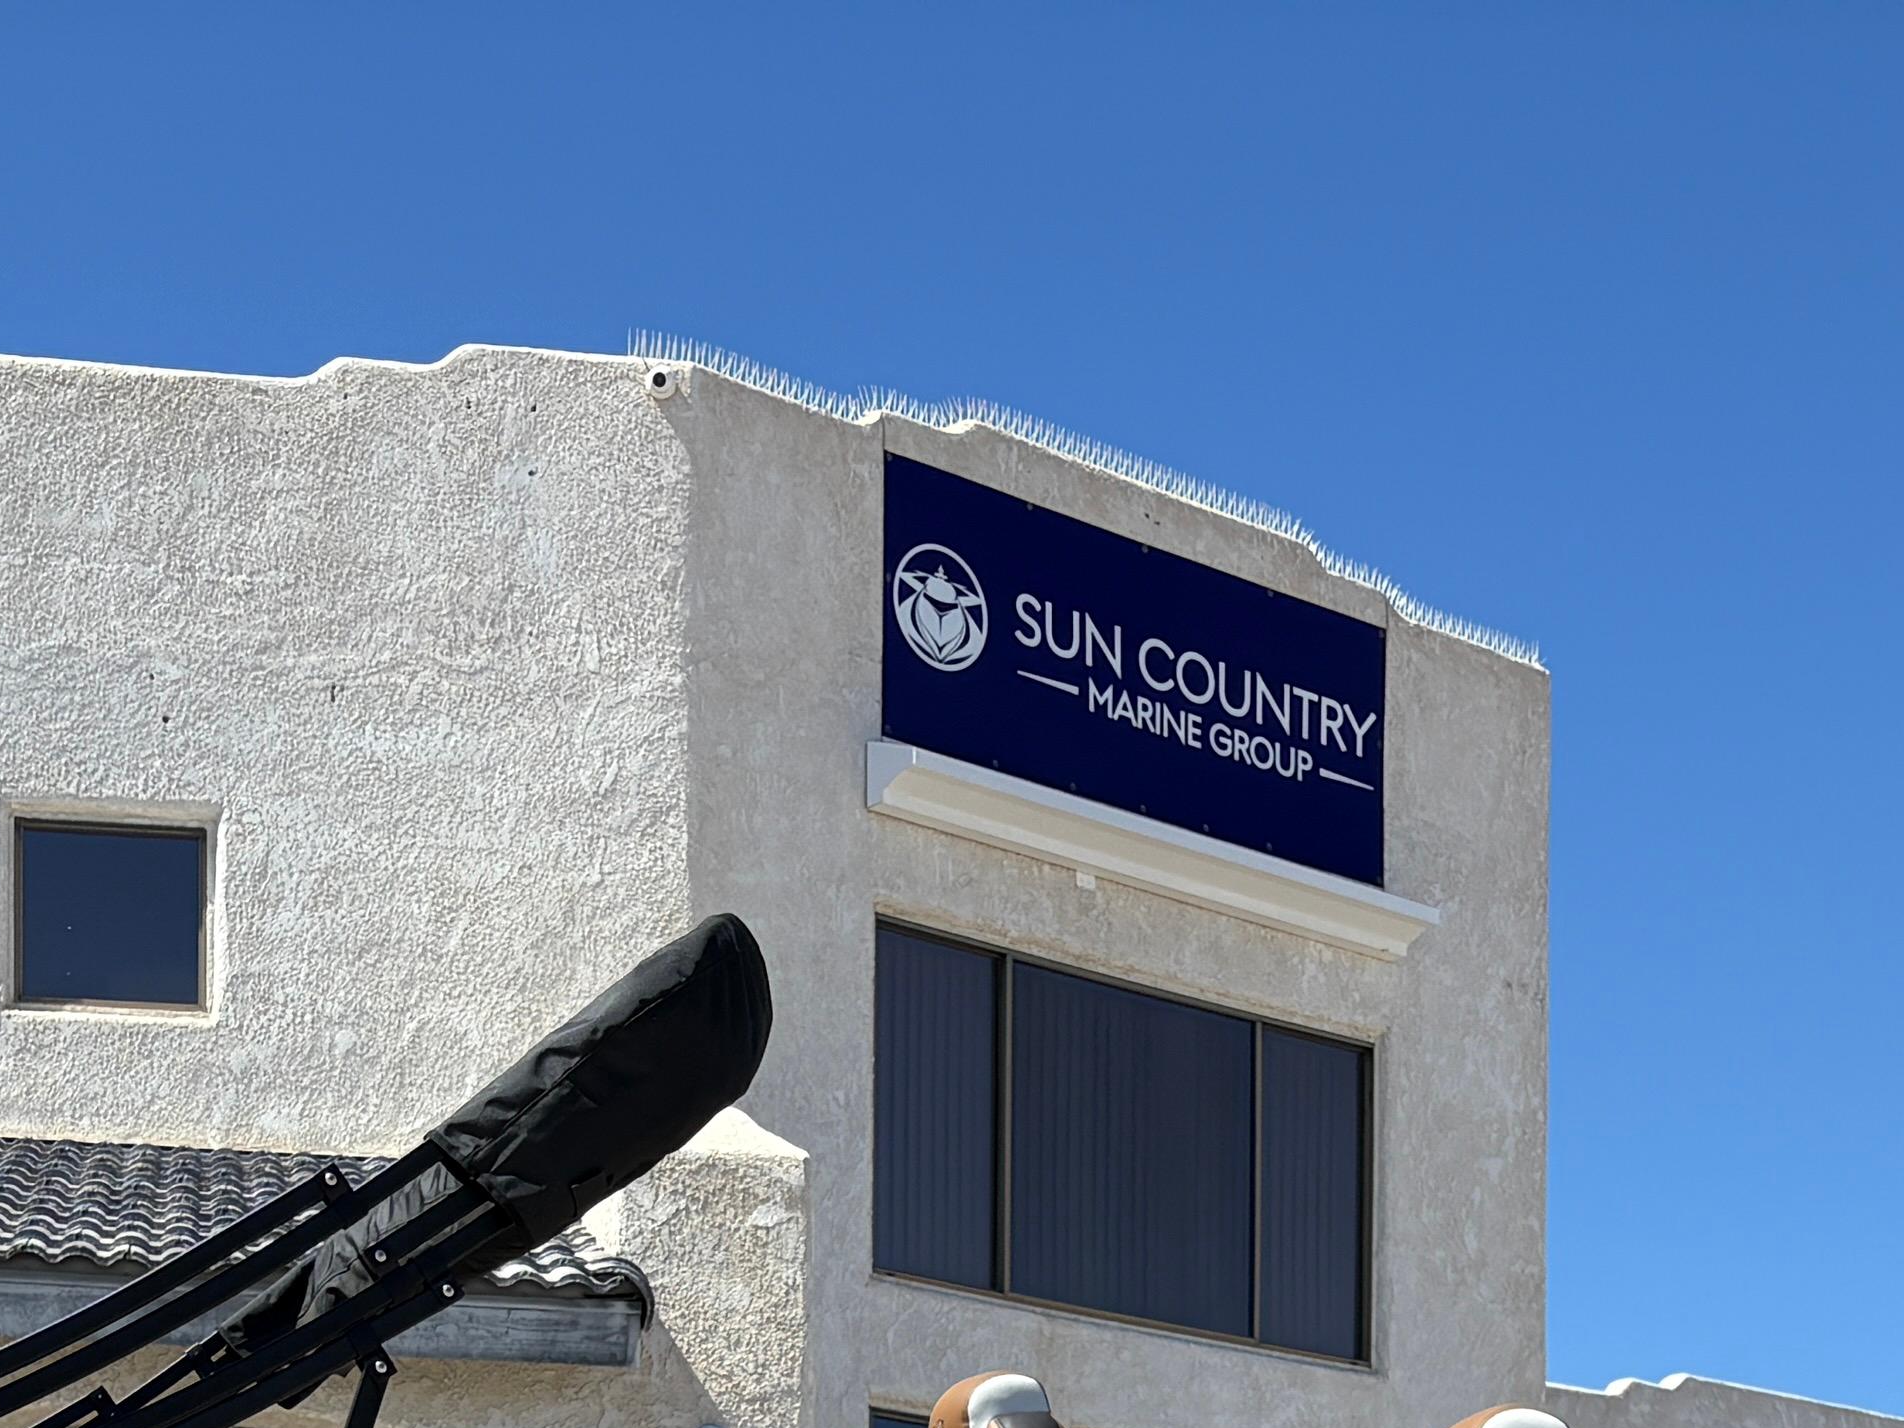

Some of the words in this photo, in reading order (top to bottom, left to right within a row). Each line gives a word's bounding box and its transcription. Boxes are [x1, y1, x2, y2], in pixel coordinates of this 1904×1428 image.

[1014, 592, 1123, 680] SUN
[1138, 637, 1377, 758] COUNTRY
[1088, 676, 1202, 750] MARINE
[1209, 722, 1313, 782] GROUP
